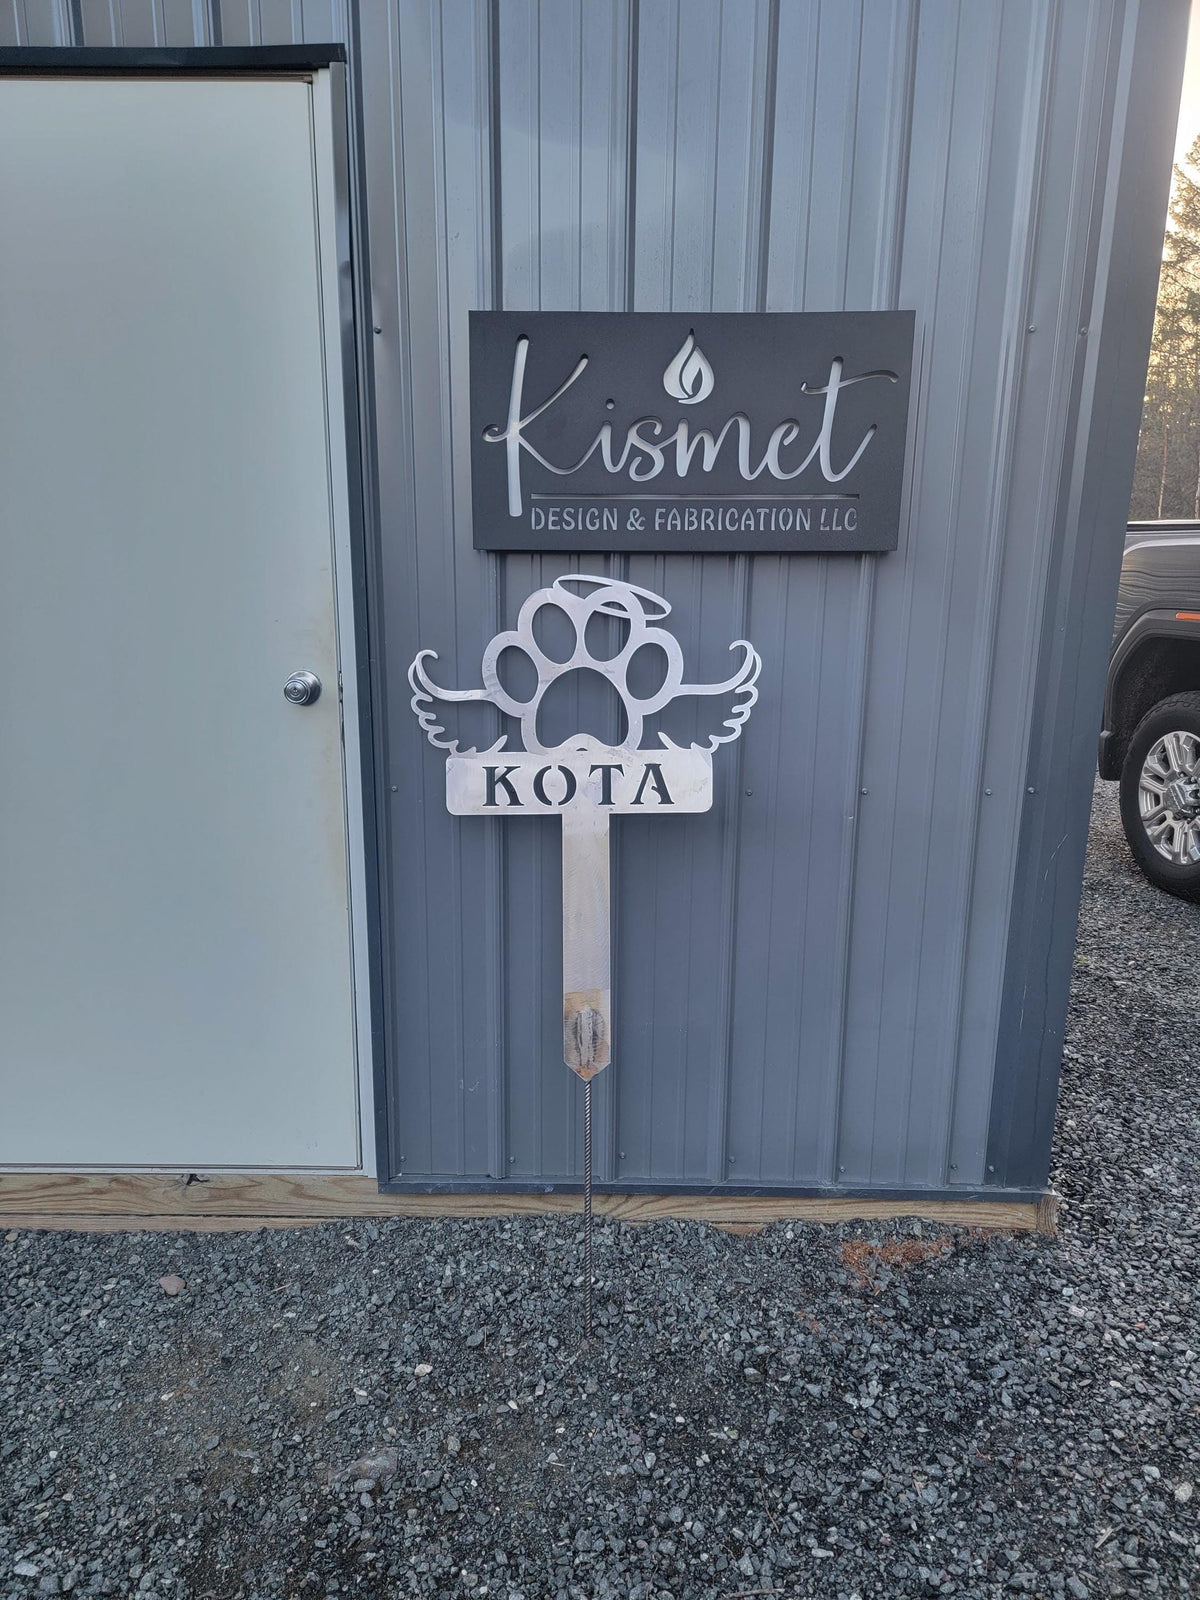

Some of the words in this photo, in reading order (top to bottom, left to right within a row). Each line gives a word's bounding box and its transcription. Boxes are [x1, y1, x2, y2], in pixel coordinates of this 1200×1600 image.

[481, 334, 899, 517] Kismet
[530, 507, 618, 531] DESIGN
[626, 508, 646, 531] &
[654, 508, 811, 531] FABRICATION
[819, 508, 858, 531] LLC
[482, 763, 675, 807] KOTA
